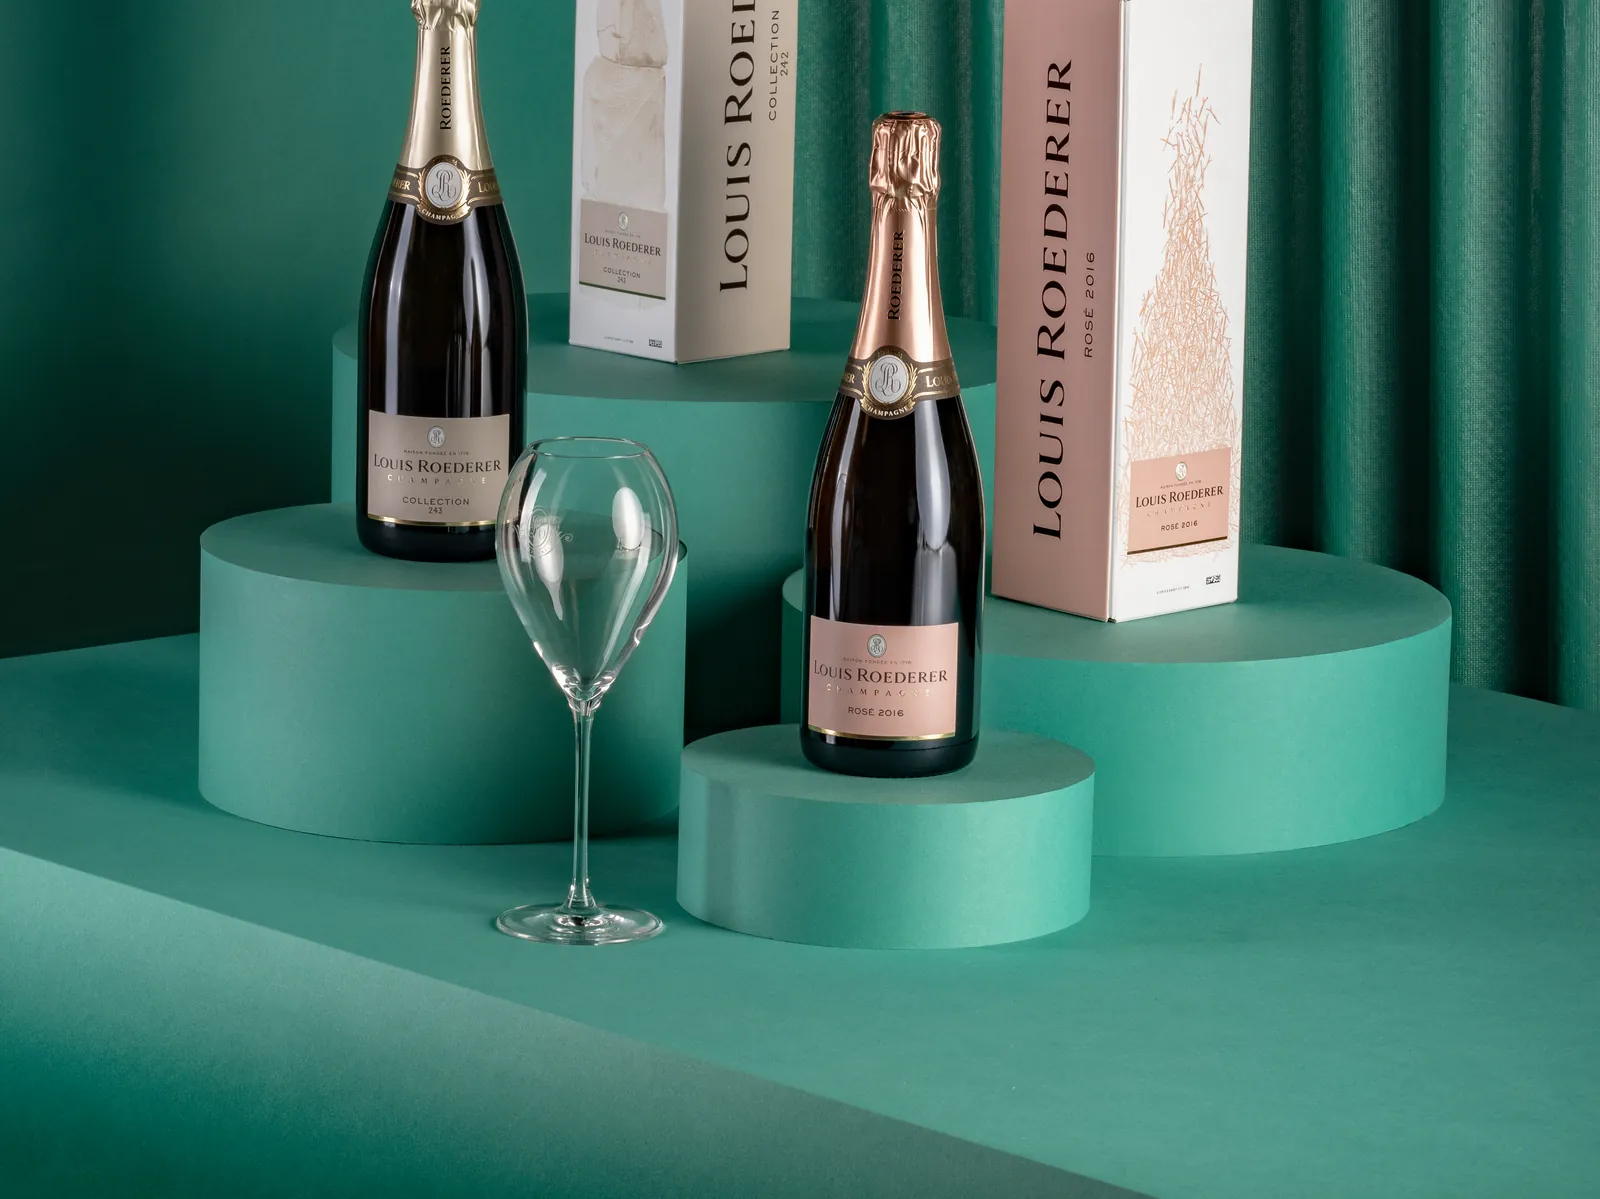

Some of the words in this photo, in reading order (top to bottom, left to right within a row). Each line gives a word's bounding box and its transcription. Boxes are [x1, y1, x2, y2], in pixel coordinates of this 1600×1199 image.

[768, 9, 780, 121] COLLECTION
[780, 51, 789, 77] 242
[439, 45, 451, 130] ROEDERER
[719, 141, 752, 293] LOUIS
[1036, 59, 1073, 361] ROEDERER
[584, 232, 611, 248] LOUIS
[612, 238, 662, 257] ROEDERER
[603, 266, 641, 279] COLLECTION
[887, 230, 904, 320] ROEDERER
[1085, 250, 1096, 299] 2016
[1084, 307, 1094, 359] ROSÉ
[374, 453, 413, 473] LOUIS
[418, 459, 502, 474] ROEDERER
[1032, 377, 1065, 541] LOUIS
[402, 496, 470, 506] COLLECTION
[1135, 493, 1167, 508] LOUIS
[1169, 485, 1224, 503] ROEDERER
[428, 506, 443, 515] 243
[1160, 522, 1179, 532] ROSÉ
[1181, 519, 1198, 529] 2016
[813, 660, 852, 681] LOUIS
[857, 667, 948, 684] ROEDERER
[847, 706, 875, 717] ROSÉ
[878, 709, 905, 717] 2016
